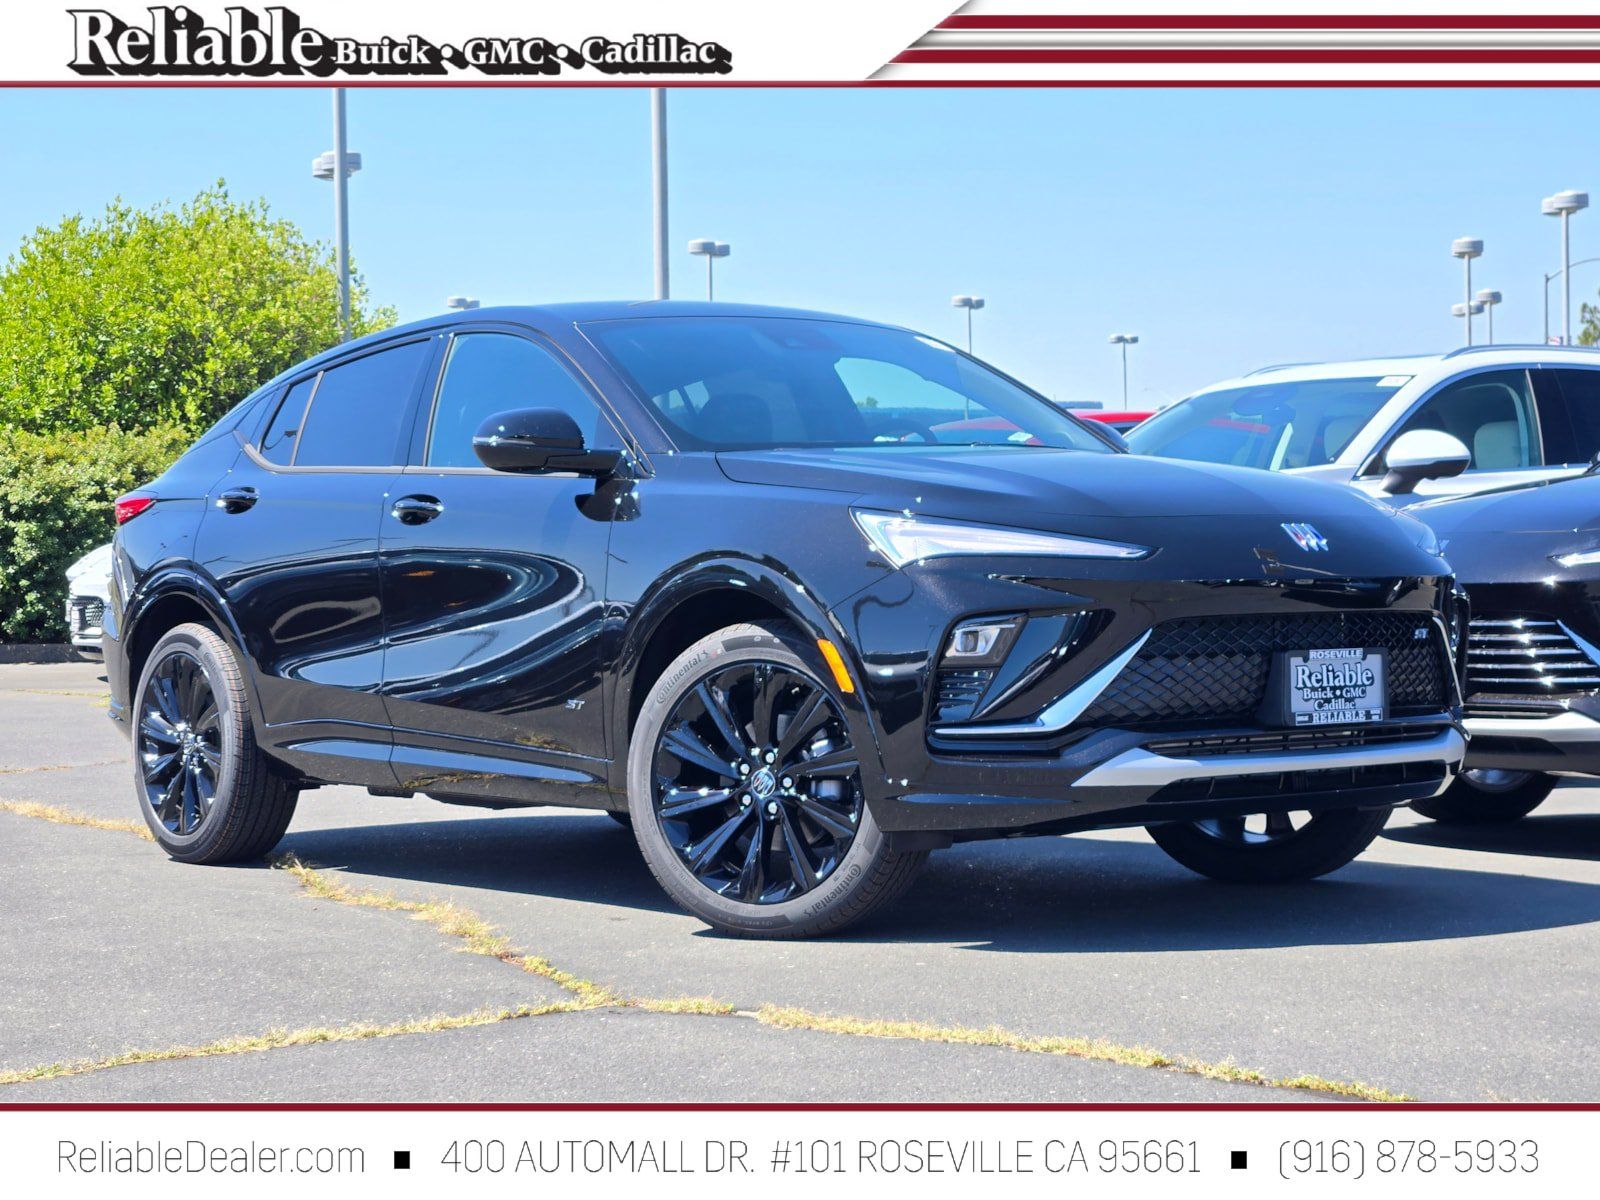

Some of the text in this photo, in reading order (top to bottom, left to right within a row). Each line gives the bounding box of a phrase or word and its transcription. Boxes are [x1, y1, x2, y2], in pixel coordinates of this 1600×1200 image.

[1309, 649, 1363, 660] ROSEVILLE
[1296, 663, 1374, 688] Reliable
[1303, 686, 1366, 700] Buick GMC
[1314, 698, 1356, 711] Cadillac
[1313, 710, 1366, 724] RELIABLE
